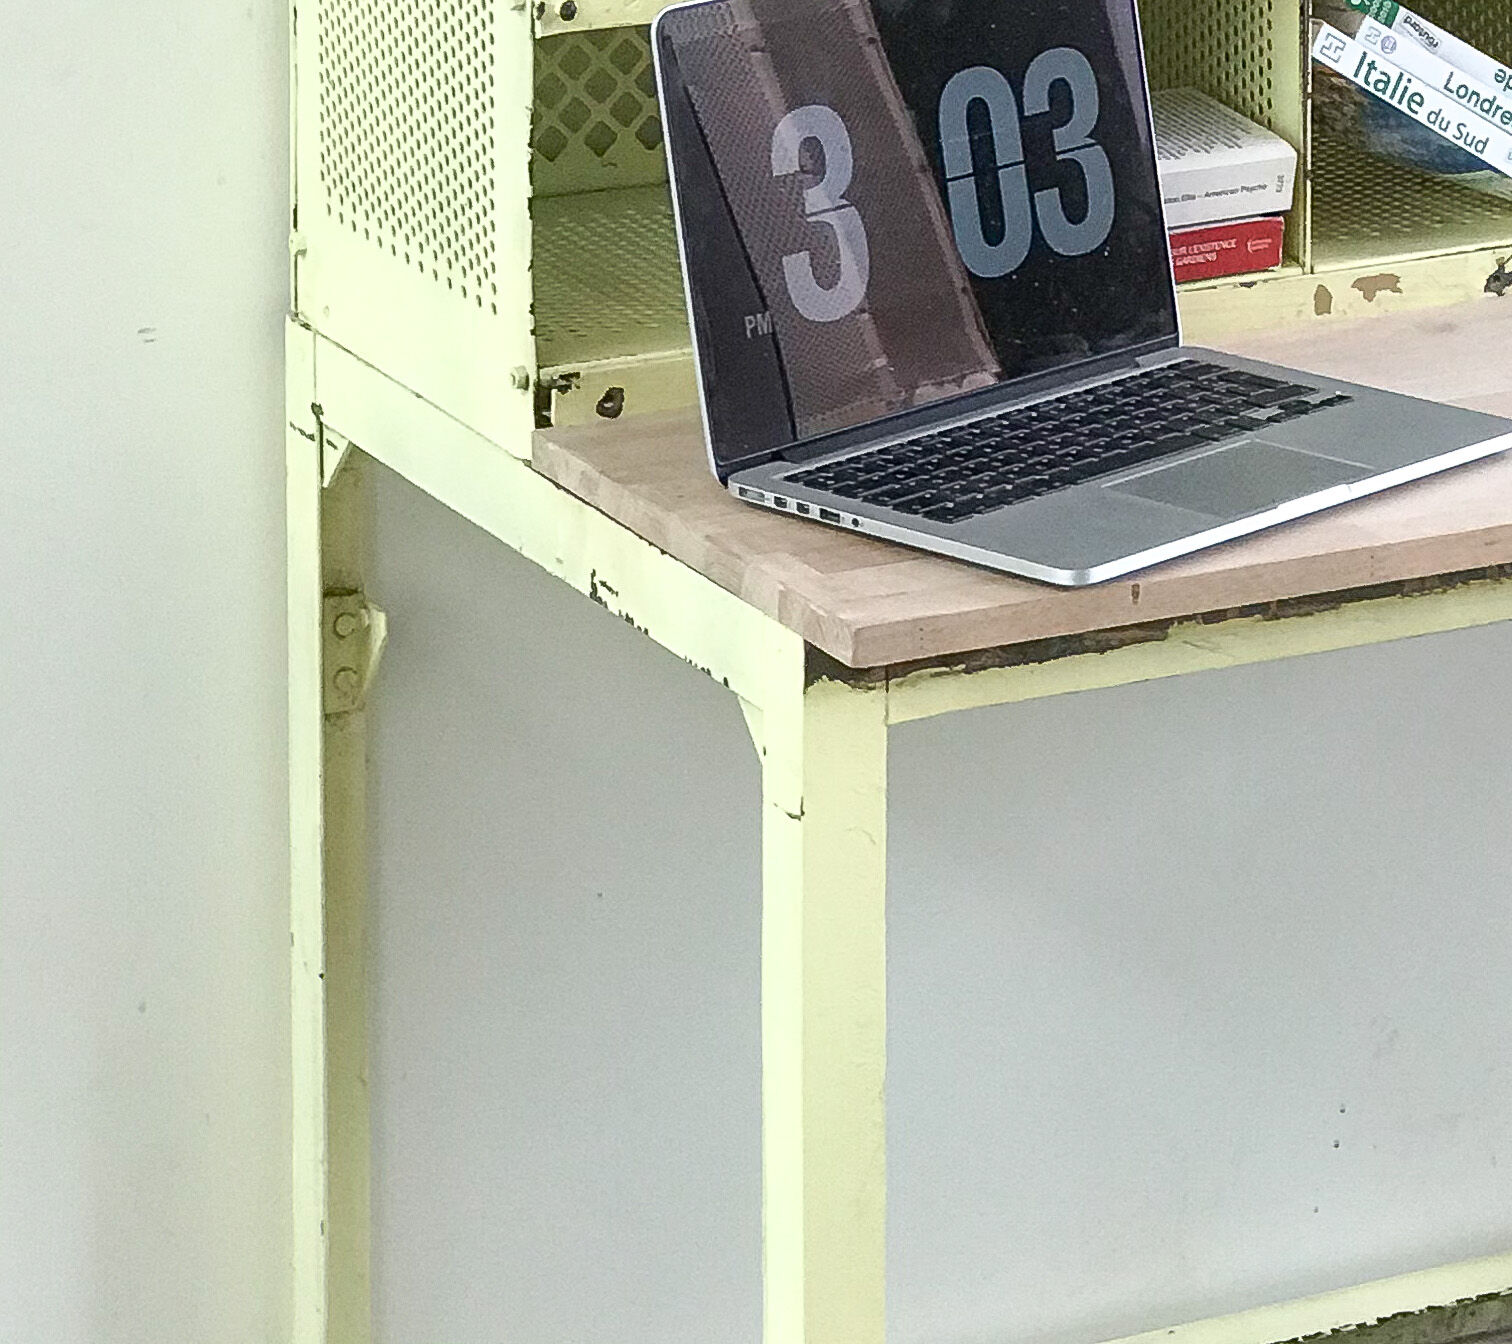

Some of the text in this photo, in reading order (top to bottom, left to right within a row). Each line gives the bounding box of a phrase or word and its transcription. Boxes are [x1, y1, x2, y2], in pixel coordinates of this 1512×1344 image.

[1403, 15, 1440, 49] routard
[1353, 50, 1489, 156] Italie du Sud
[771, 46, 1115, 322] 3 03
[744, 314, 772, 338] PM
